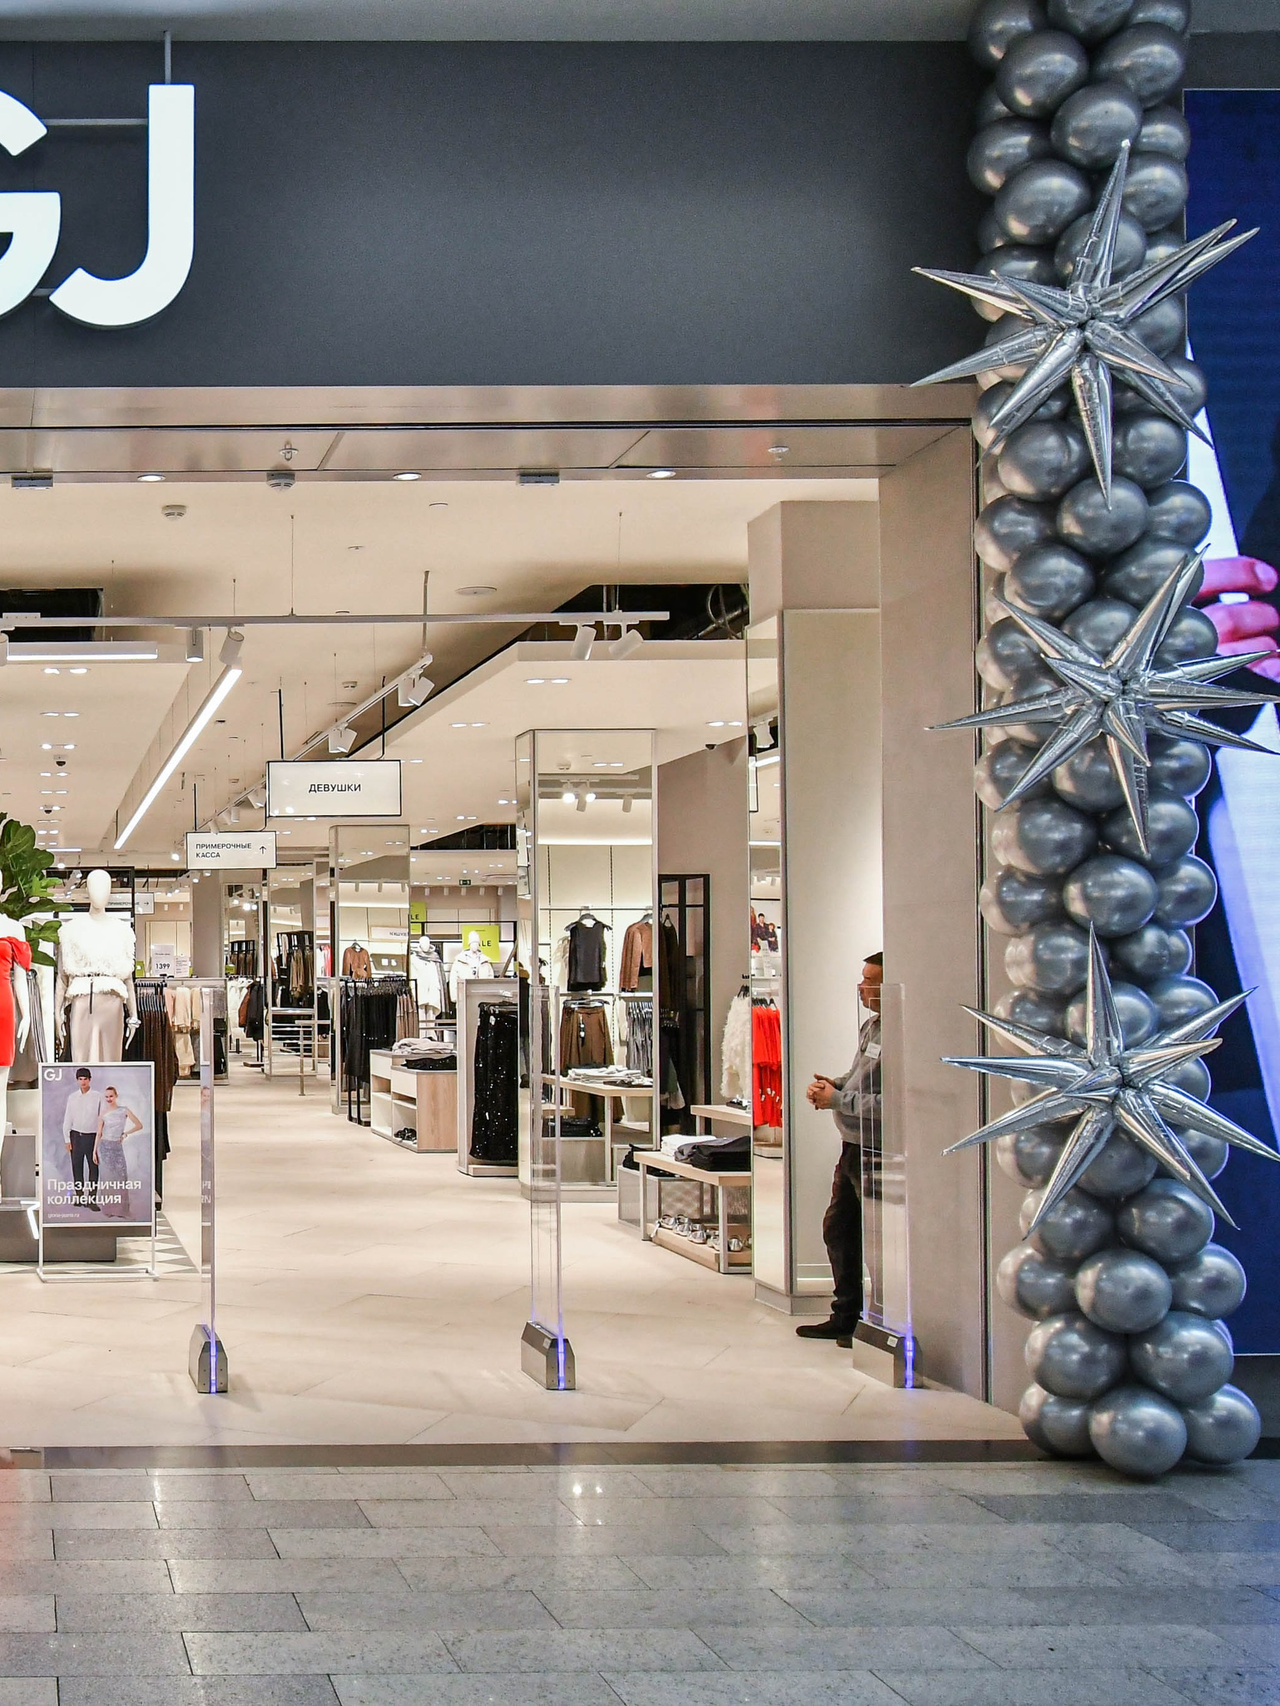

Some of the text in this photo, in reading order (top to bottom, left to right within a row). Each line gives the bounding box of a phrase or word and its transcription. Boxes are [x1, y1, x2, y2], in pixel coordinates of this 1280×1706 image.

[308, 783, 361, 794] ДЕВУШКИ
[195, 842, 252, 850] ПРИМЕРОЧНЫЕ
[195, 851, 221, 859] КАССА
[44, 1068, 63, 1081] GJ
[47, 1178, 142, 1192] Праздничная
[47, 1194, 122, 1206] коллекция
